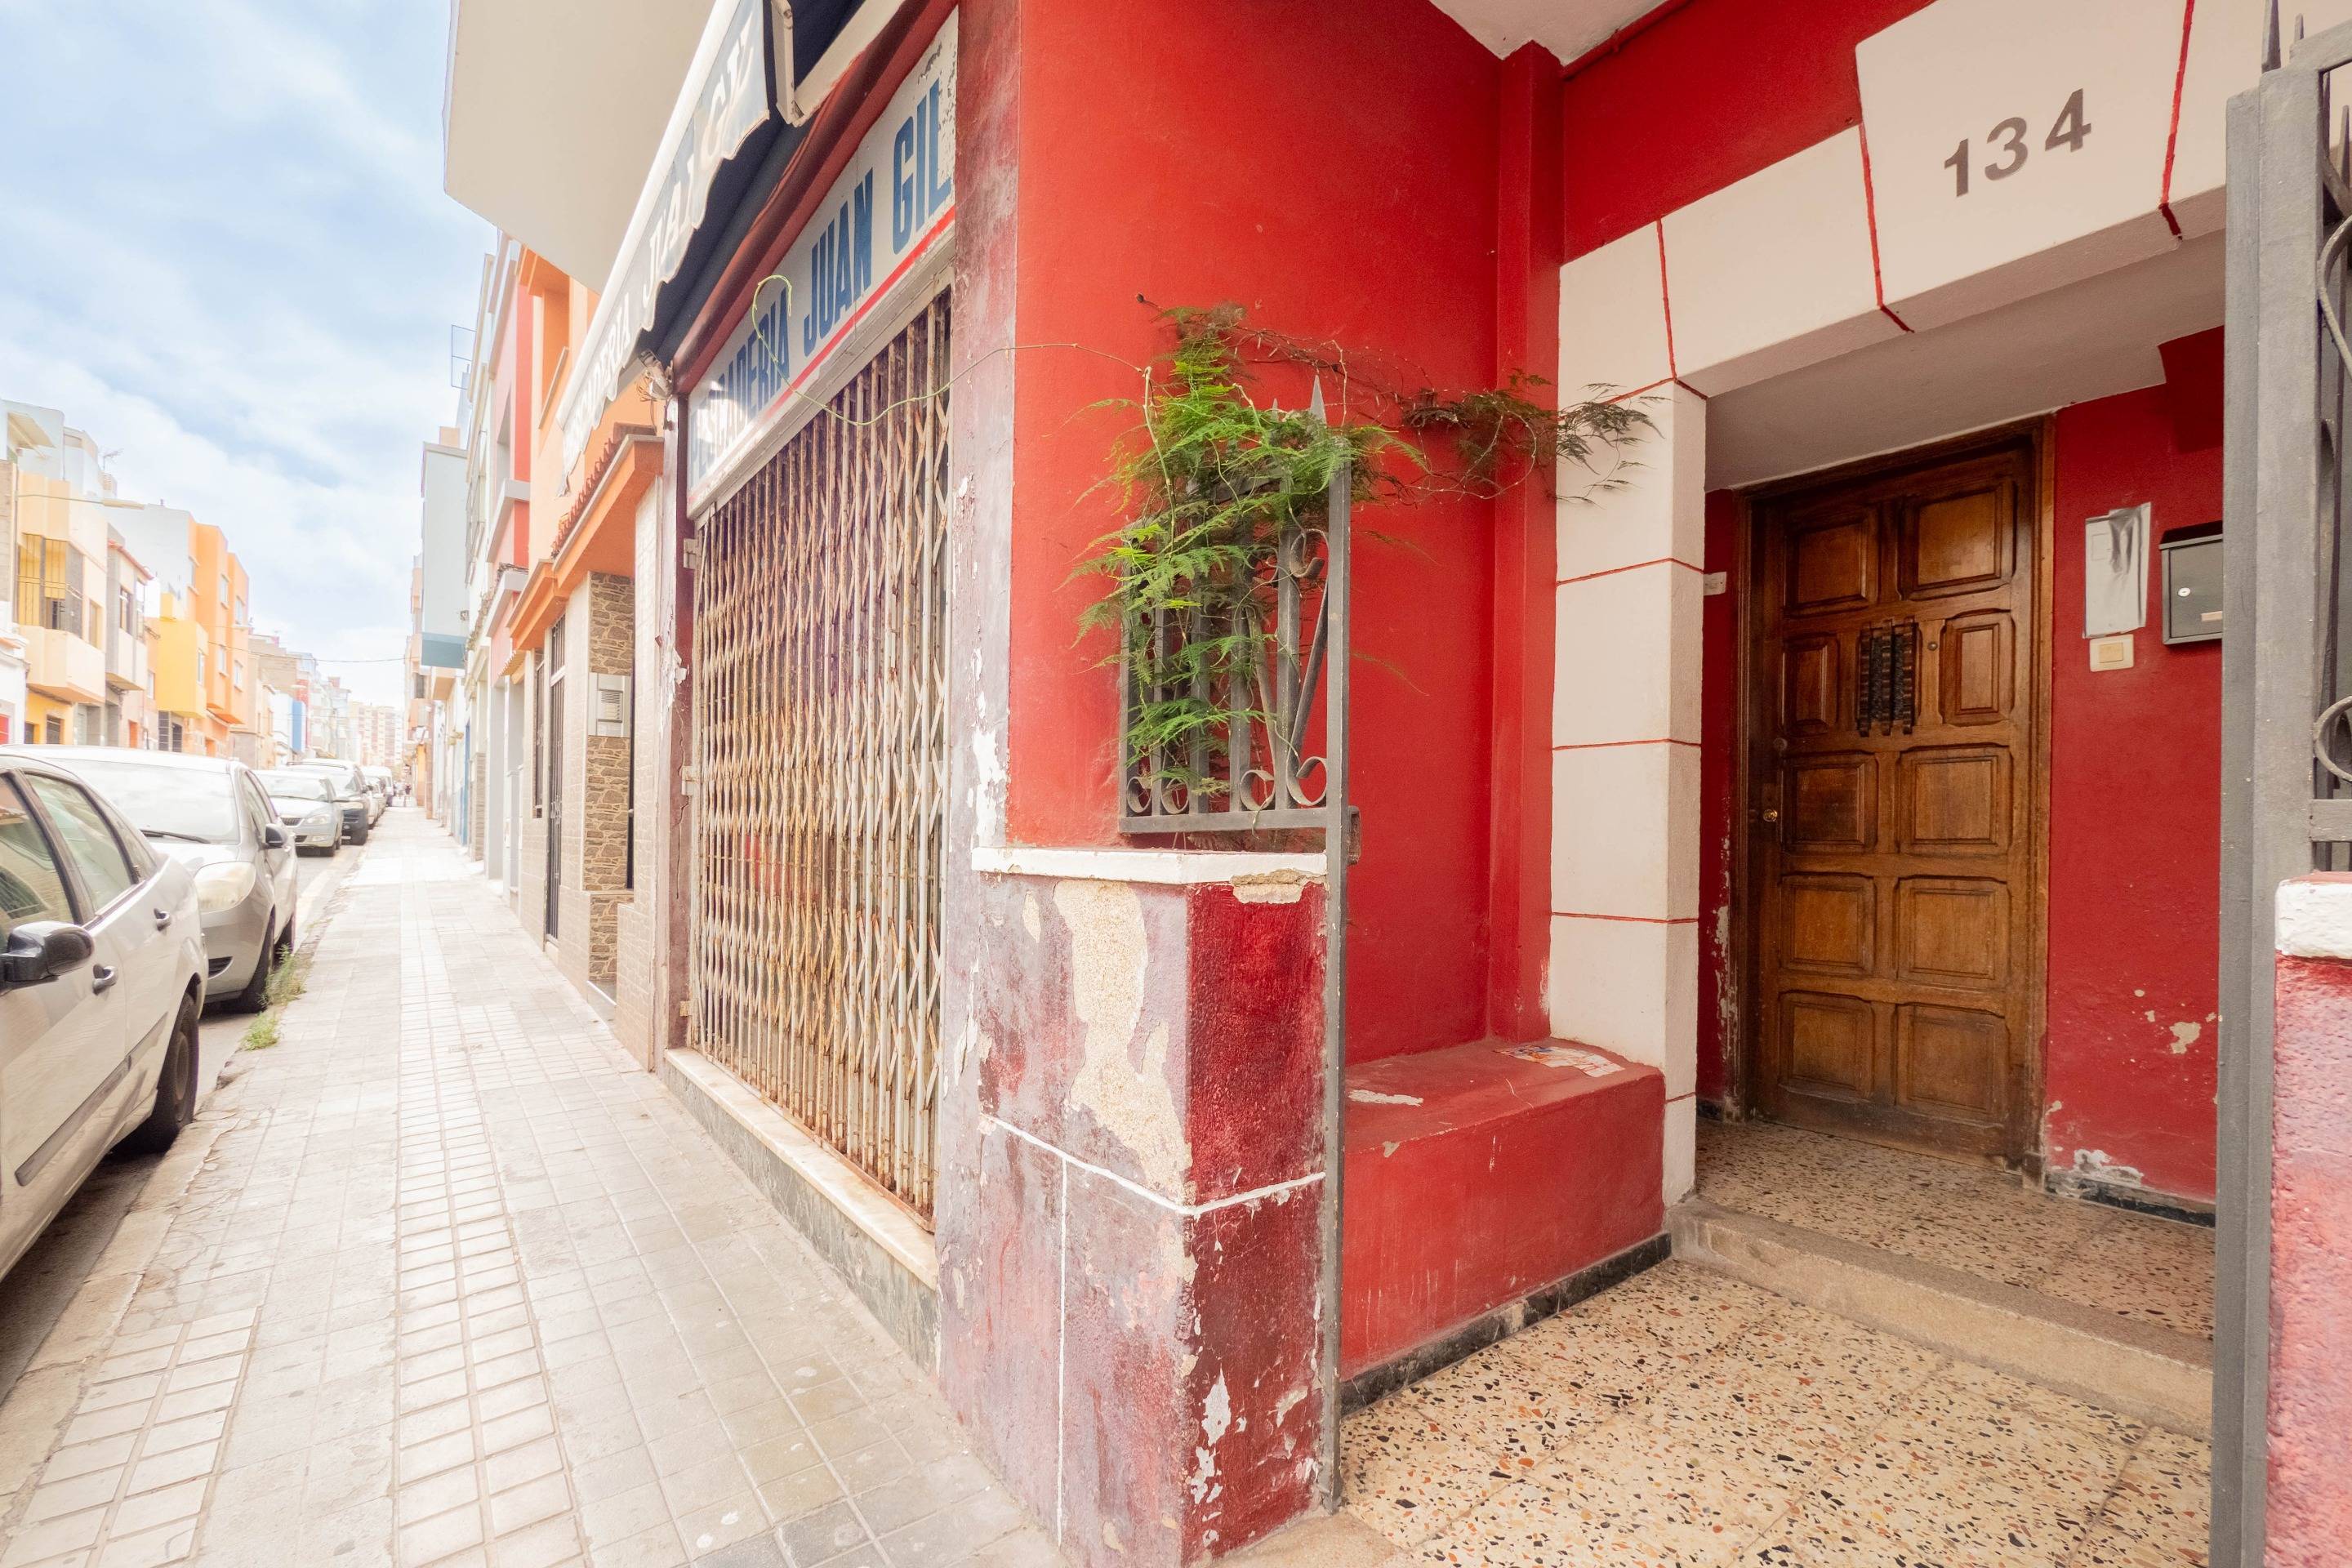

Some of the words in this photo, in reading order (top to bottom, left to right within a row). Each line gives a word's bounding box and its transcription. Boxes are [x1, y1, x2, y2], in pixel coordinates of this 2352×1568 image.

[804, 167, 874, 358] JUAN
[893, 78, 951, 256] GIL
[1944, 88, 2091, 198] 134
